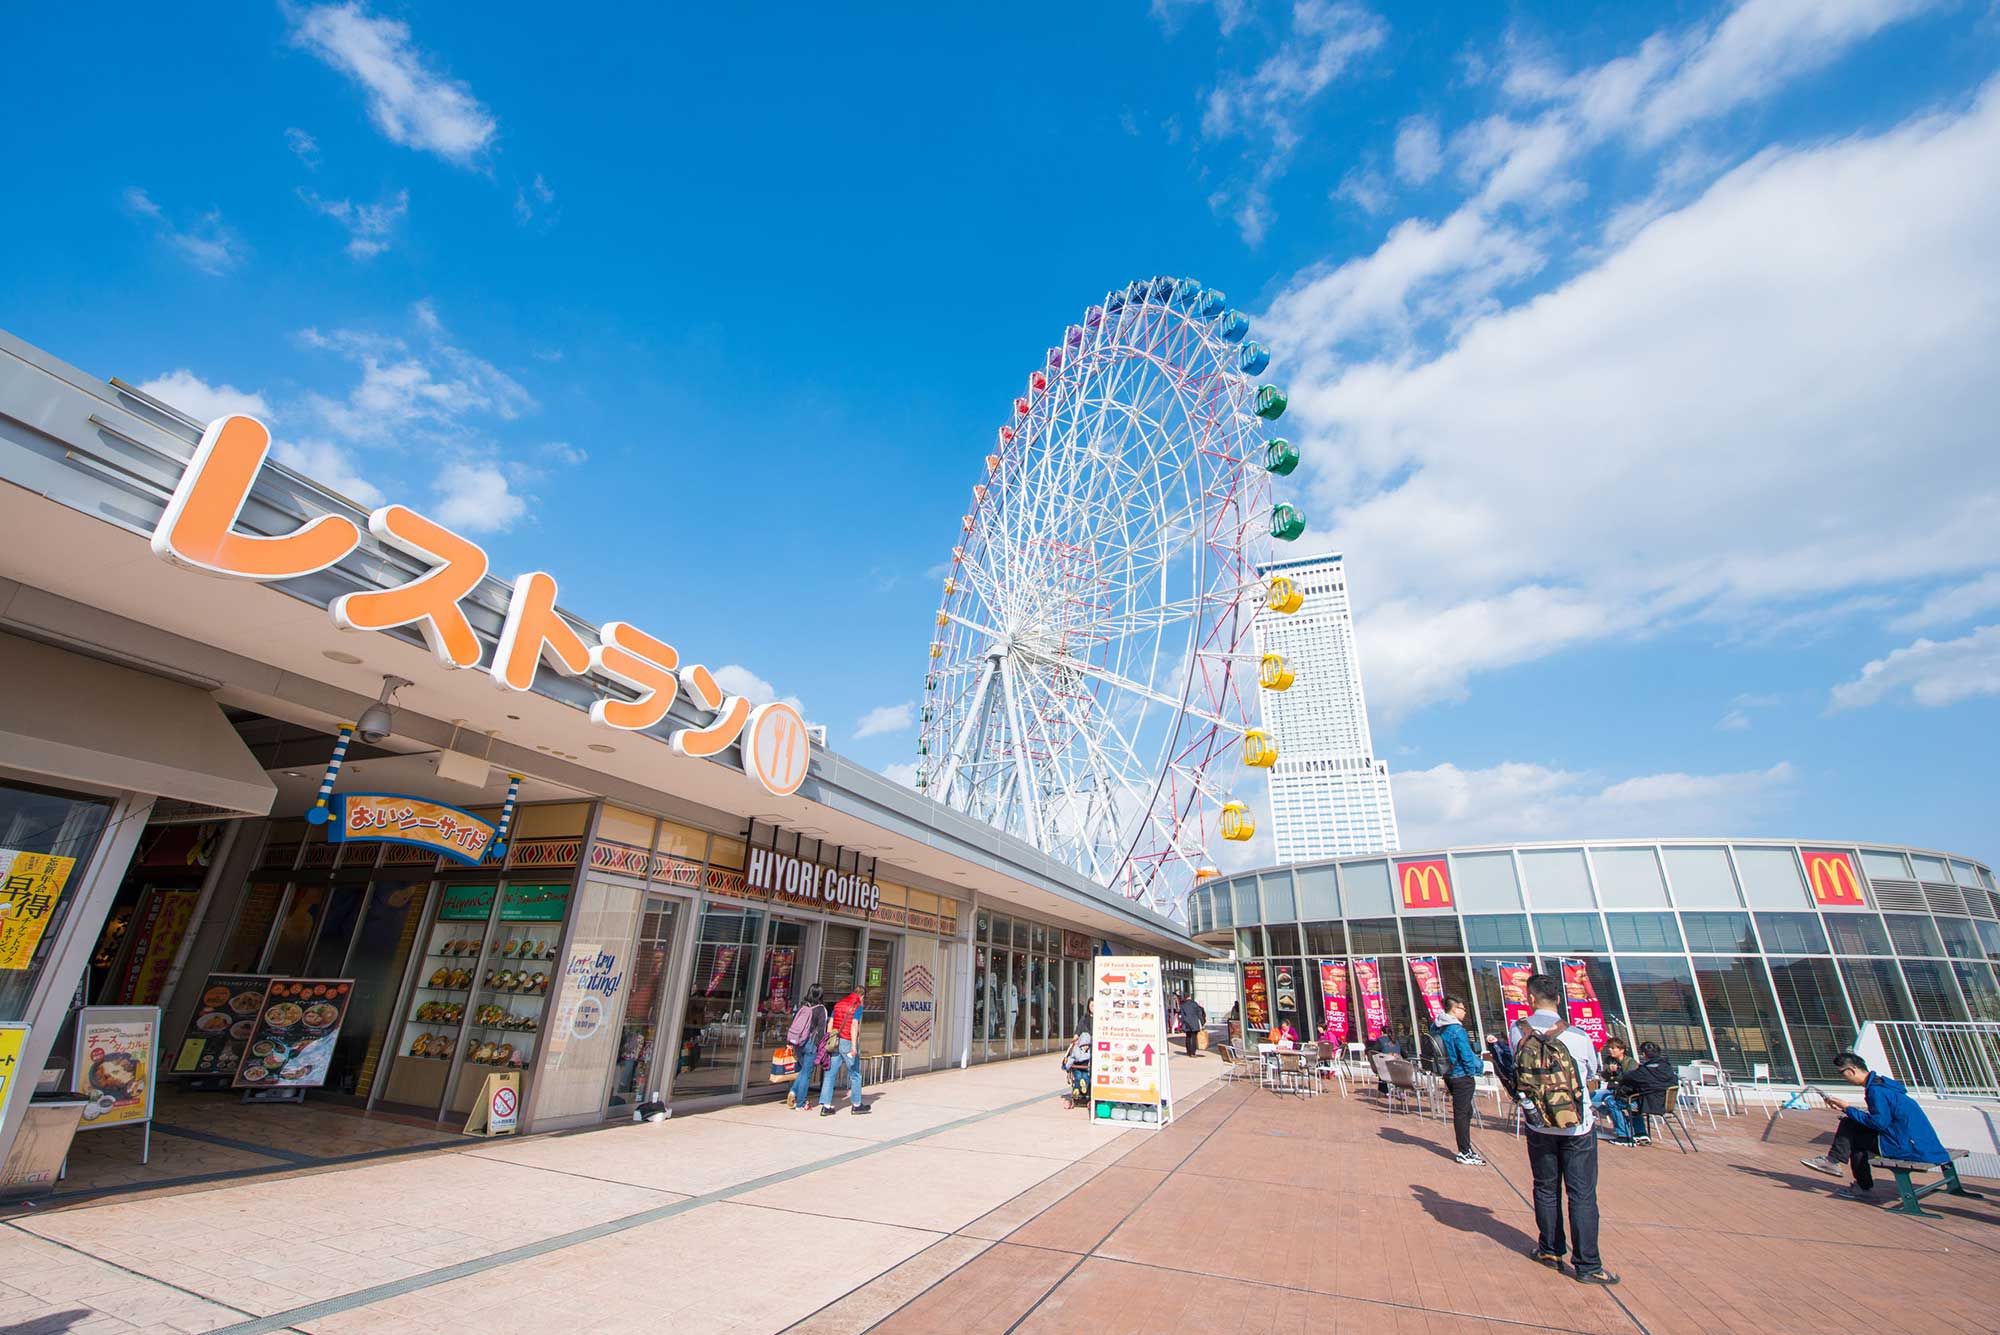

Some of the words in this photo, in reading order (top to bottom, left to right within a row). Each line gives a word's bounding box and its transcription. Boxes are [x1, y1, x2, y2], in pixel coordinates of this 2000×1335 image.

[151, 413, 751, 757] レストラン
[351, 805, 488, 850] おいシーサイド
[748, 848, 820, 899] HIYORI
[824, 868, 881, 911] Coffee
[595, 950, 615, 975] try
[901, 1001, 932, 1012] PANCAKE
